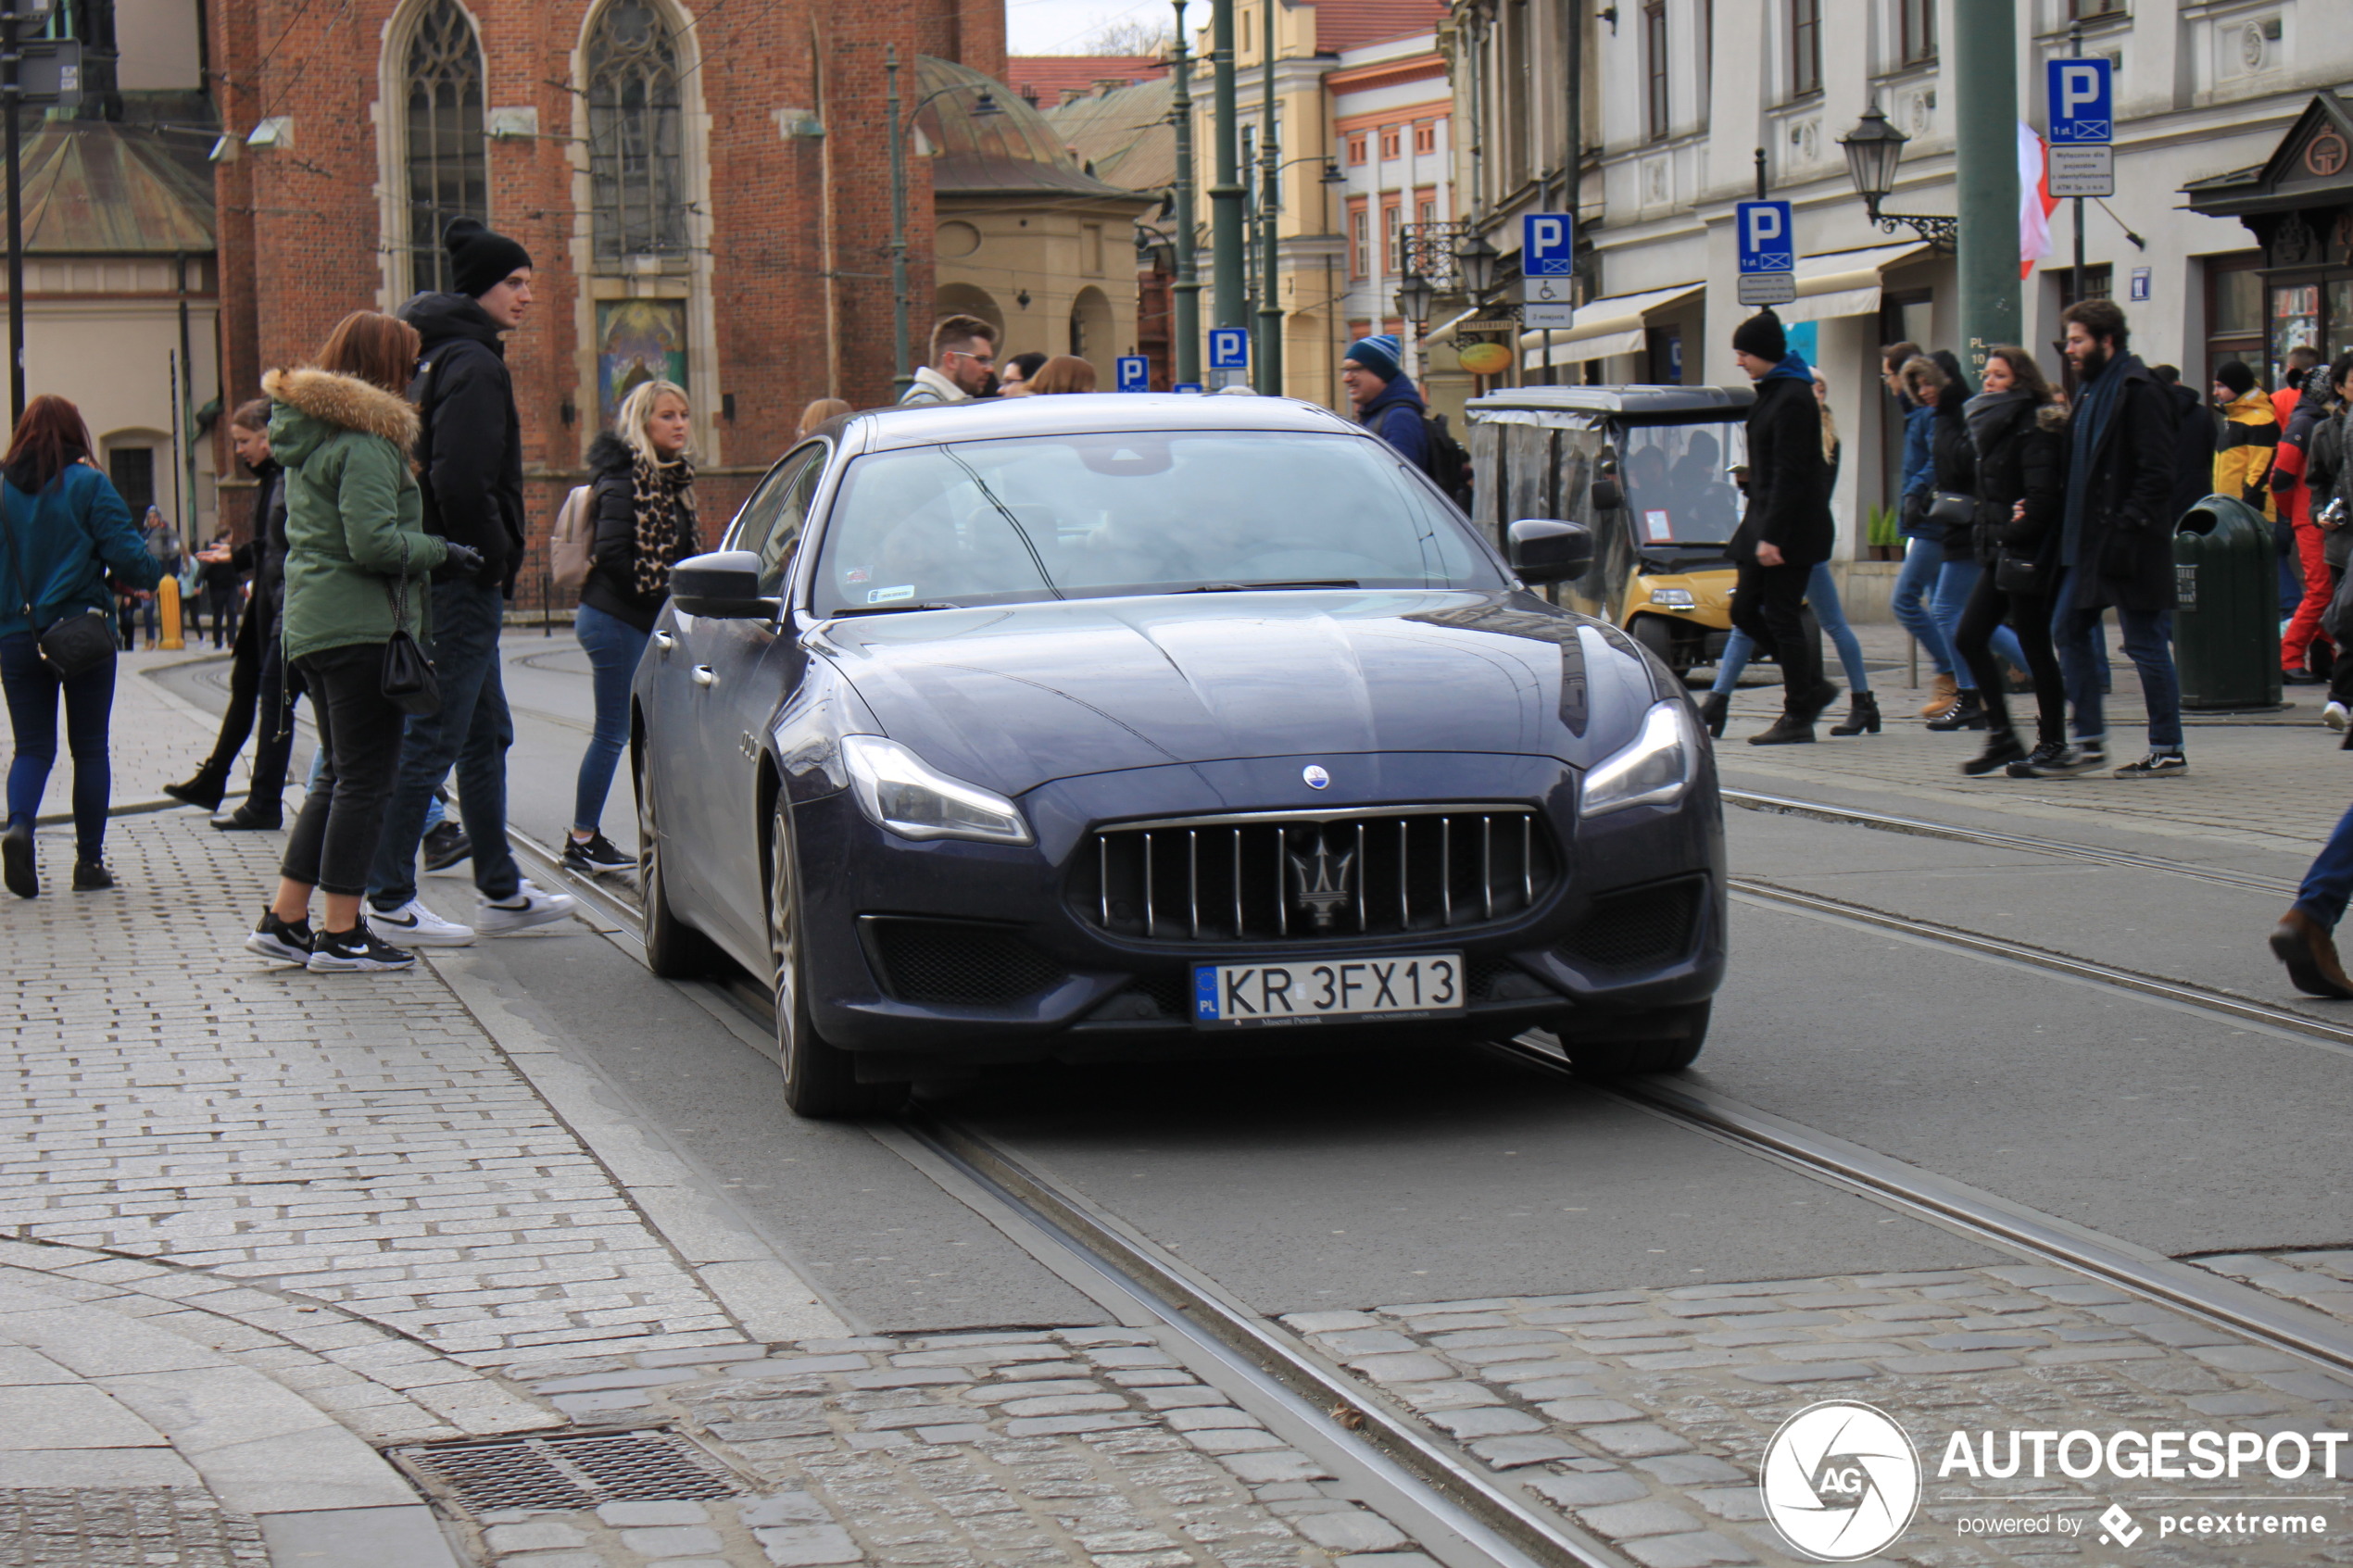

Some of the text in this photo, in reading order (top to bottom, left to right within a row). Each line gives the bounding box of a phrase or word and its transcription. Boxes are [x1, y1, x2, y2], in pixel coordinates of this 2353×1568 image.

[2062, 66, 2099, 119] P
[2053, 127, 2058, 135] 1
[1534, 219, 1562, 257] P
[1749, 207, 1782, 252] P
[1742, 258, 1746, 267] 1
[1216, 332, 1239, 365] P
[1970, 337, 1986, 348] PL
[1123, 359, 1142, 386] P
[1971, 354, 1985, 364] 10
[1226, 960, 1454, 1014] KR 3FX13
[1200, 1000, 1216, 1012] PL
